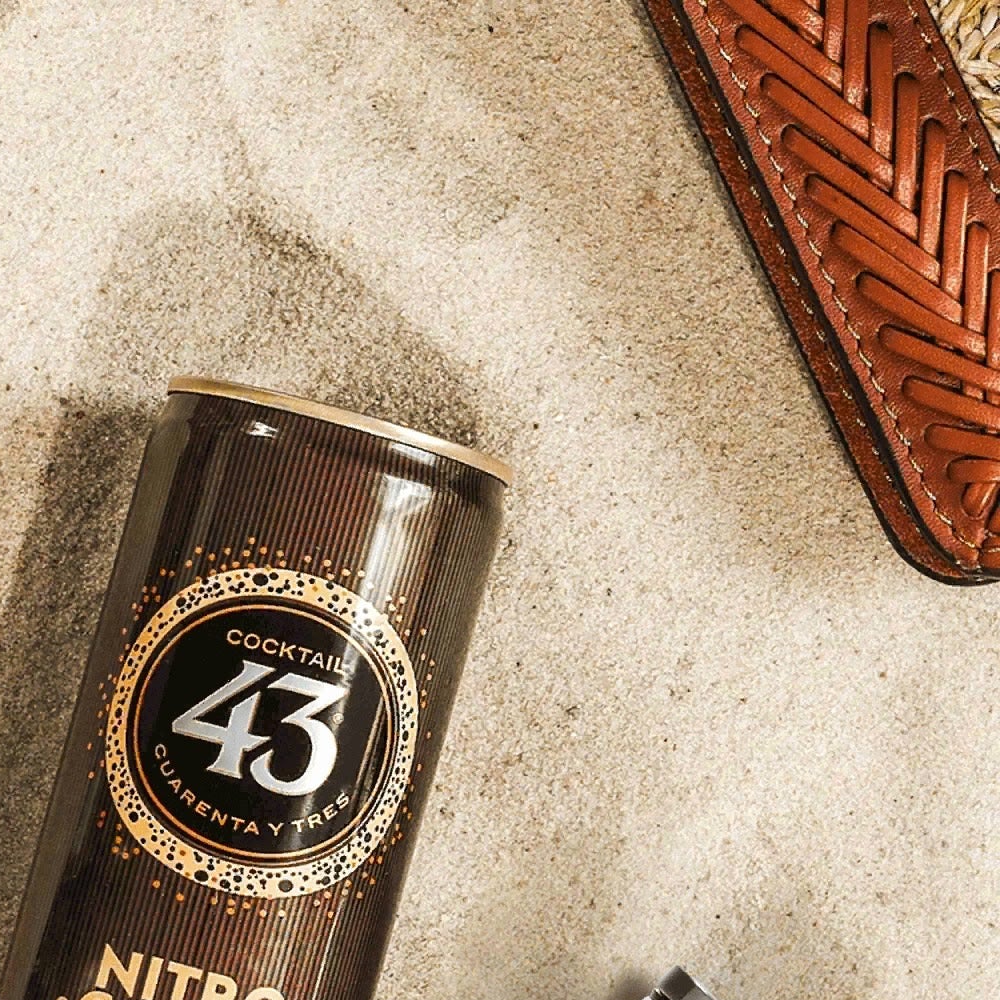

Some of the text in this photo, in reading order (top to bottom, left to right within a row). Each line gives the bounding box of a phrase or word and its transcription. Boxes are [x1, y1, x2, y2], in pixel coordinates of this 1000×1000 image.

[226, 628, 347, 674] COCKTAIL
[171, 659, 350, 797] 43
[154, 743, 350, 837] CUARENTA Y TRES
